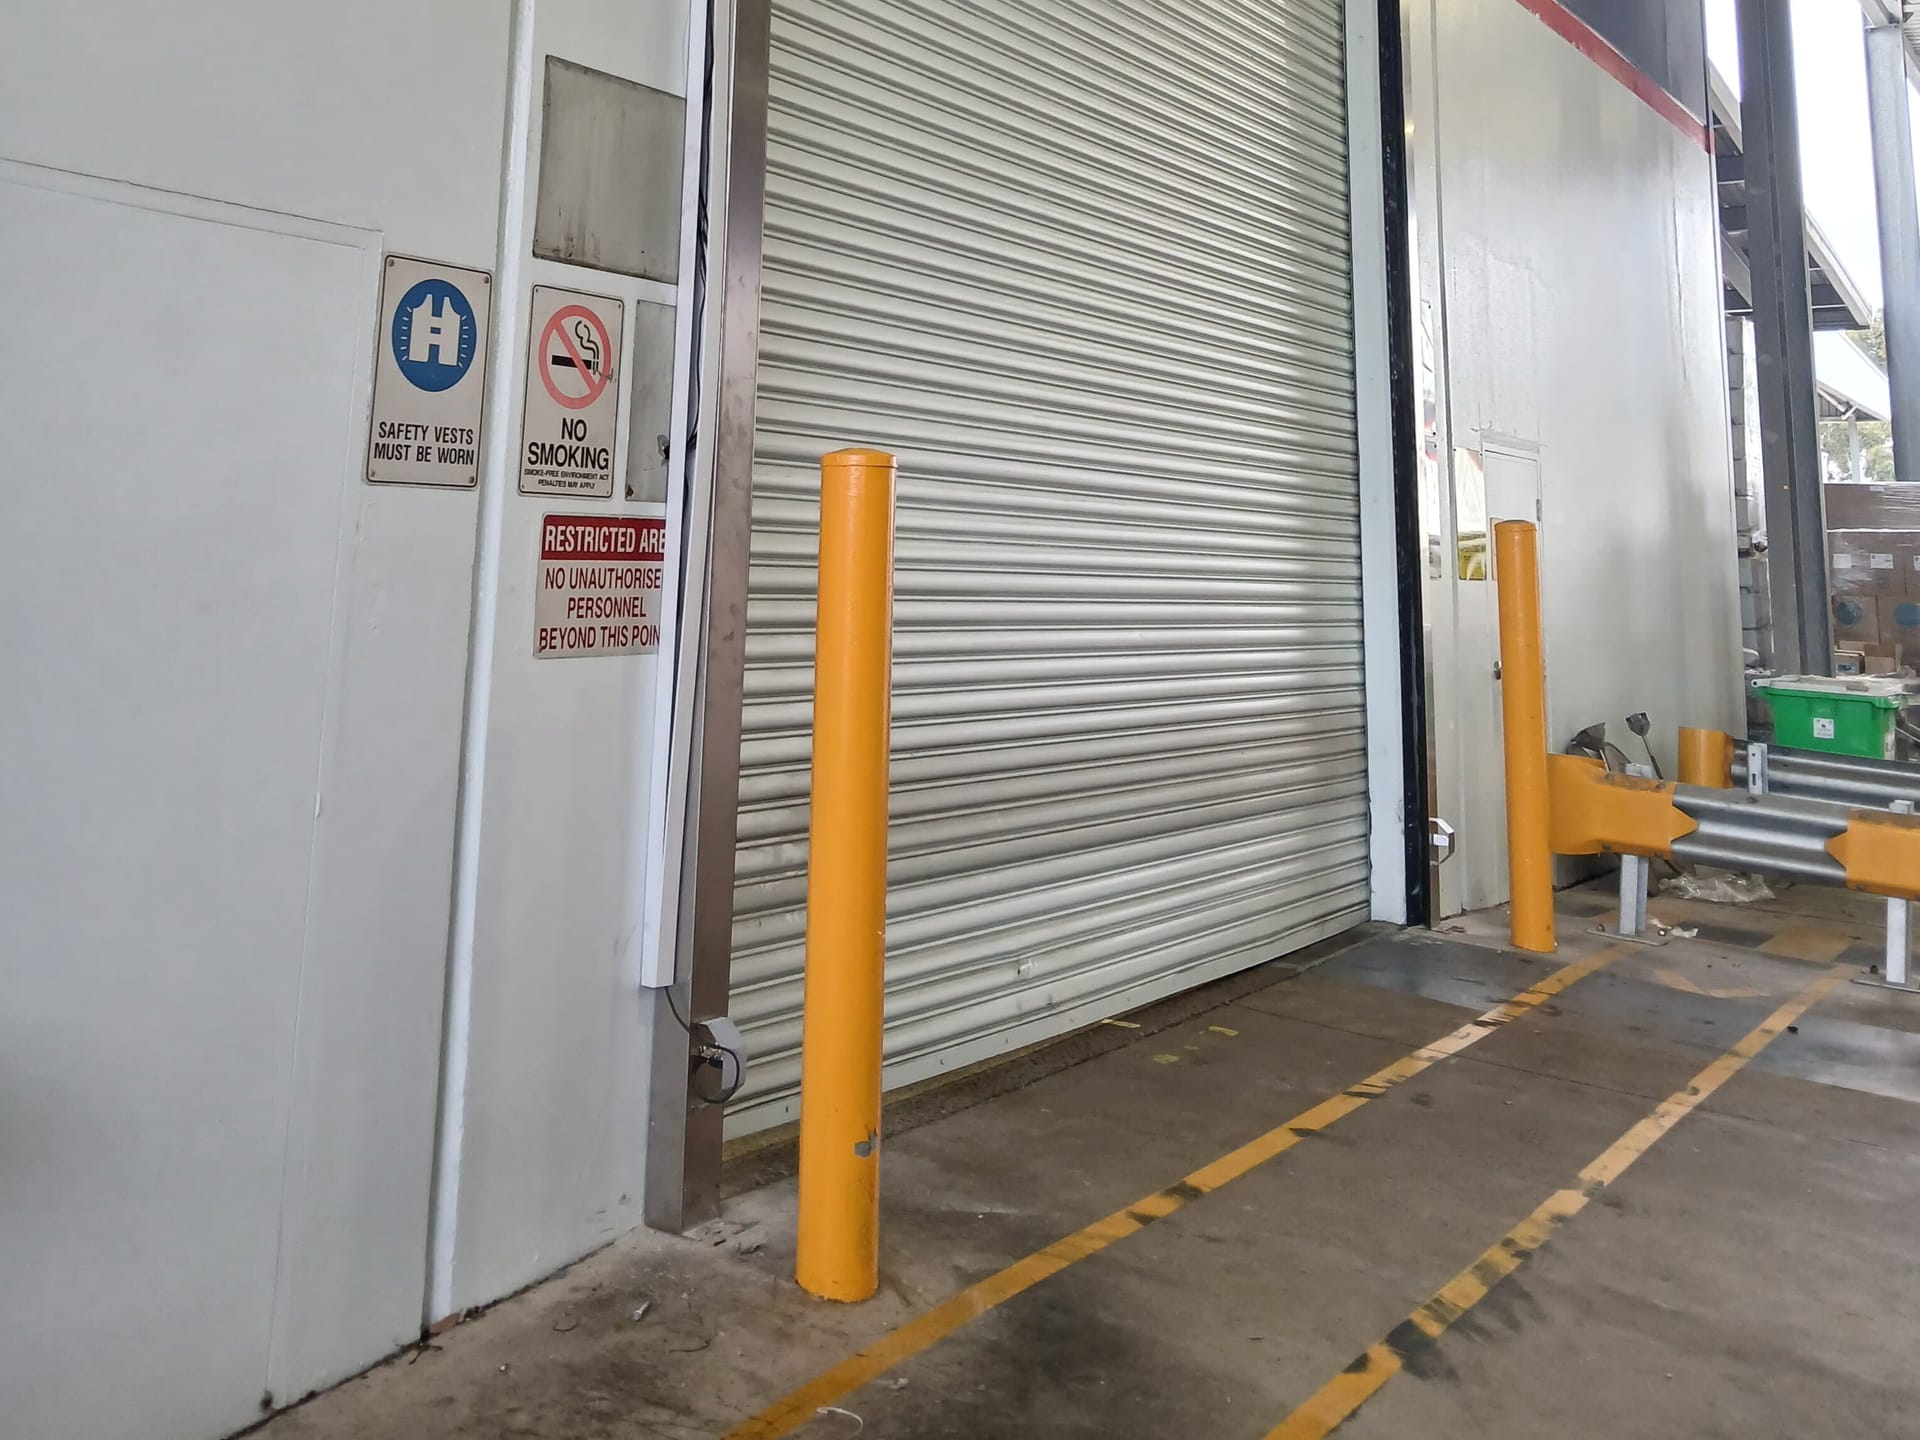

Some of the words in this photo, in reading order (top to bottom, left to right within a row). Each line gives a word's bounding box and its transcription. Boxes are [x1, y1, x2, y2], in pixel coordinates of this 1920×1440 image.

[378, 421, 429, 441] SAFETY
[434, 426, 474, 445] VESTS
[561, 417, 587, 442] NO
[374, 442, 412, 461] MUST
[416, 446, 432, 462] BE
[437, 447, 474, 465] WORN
[527, 441, 609, 470] SMOKING
[544, 525, 636, 553] RESTRICTED
[639, 528, 666, 553] ARE
[545, 567, 565, 590] NO
[569, 567, 662, 590] UNAUTHORISE
[567, 596, 647, 619] PERSONNEL
[539, 626, 597, 650] BEYOND
[600, 625, 629, 648] THIS
[631, 624, 661, 646] POIN
